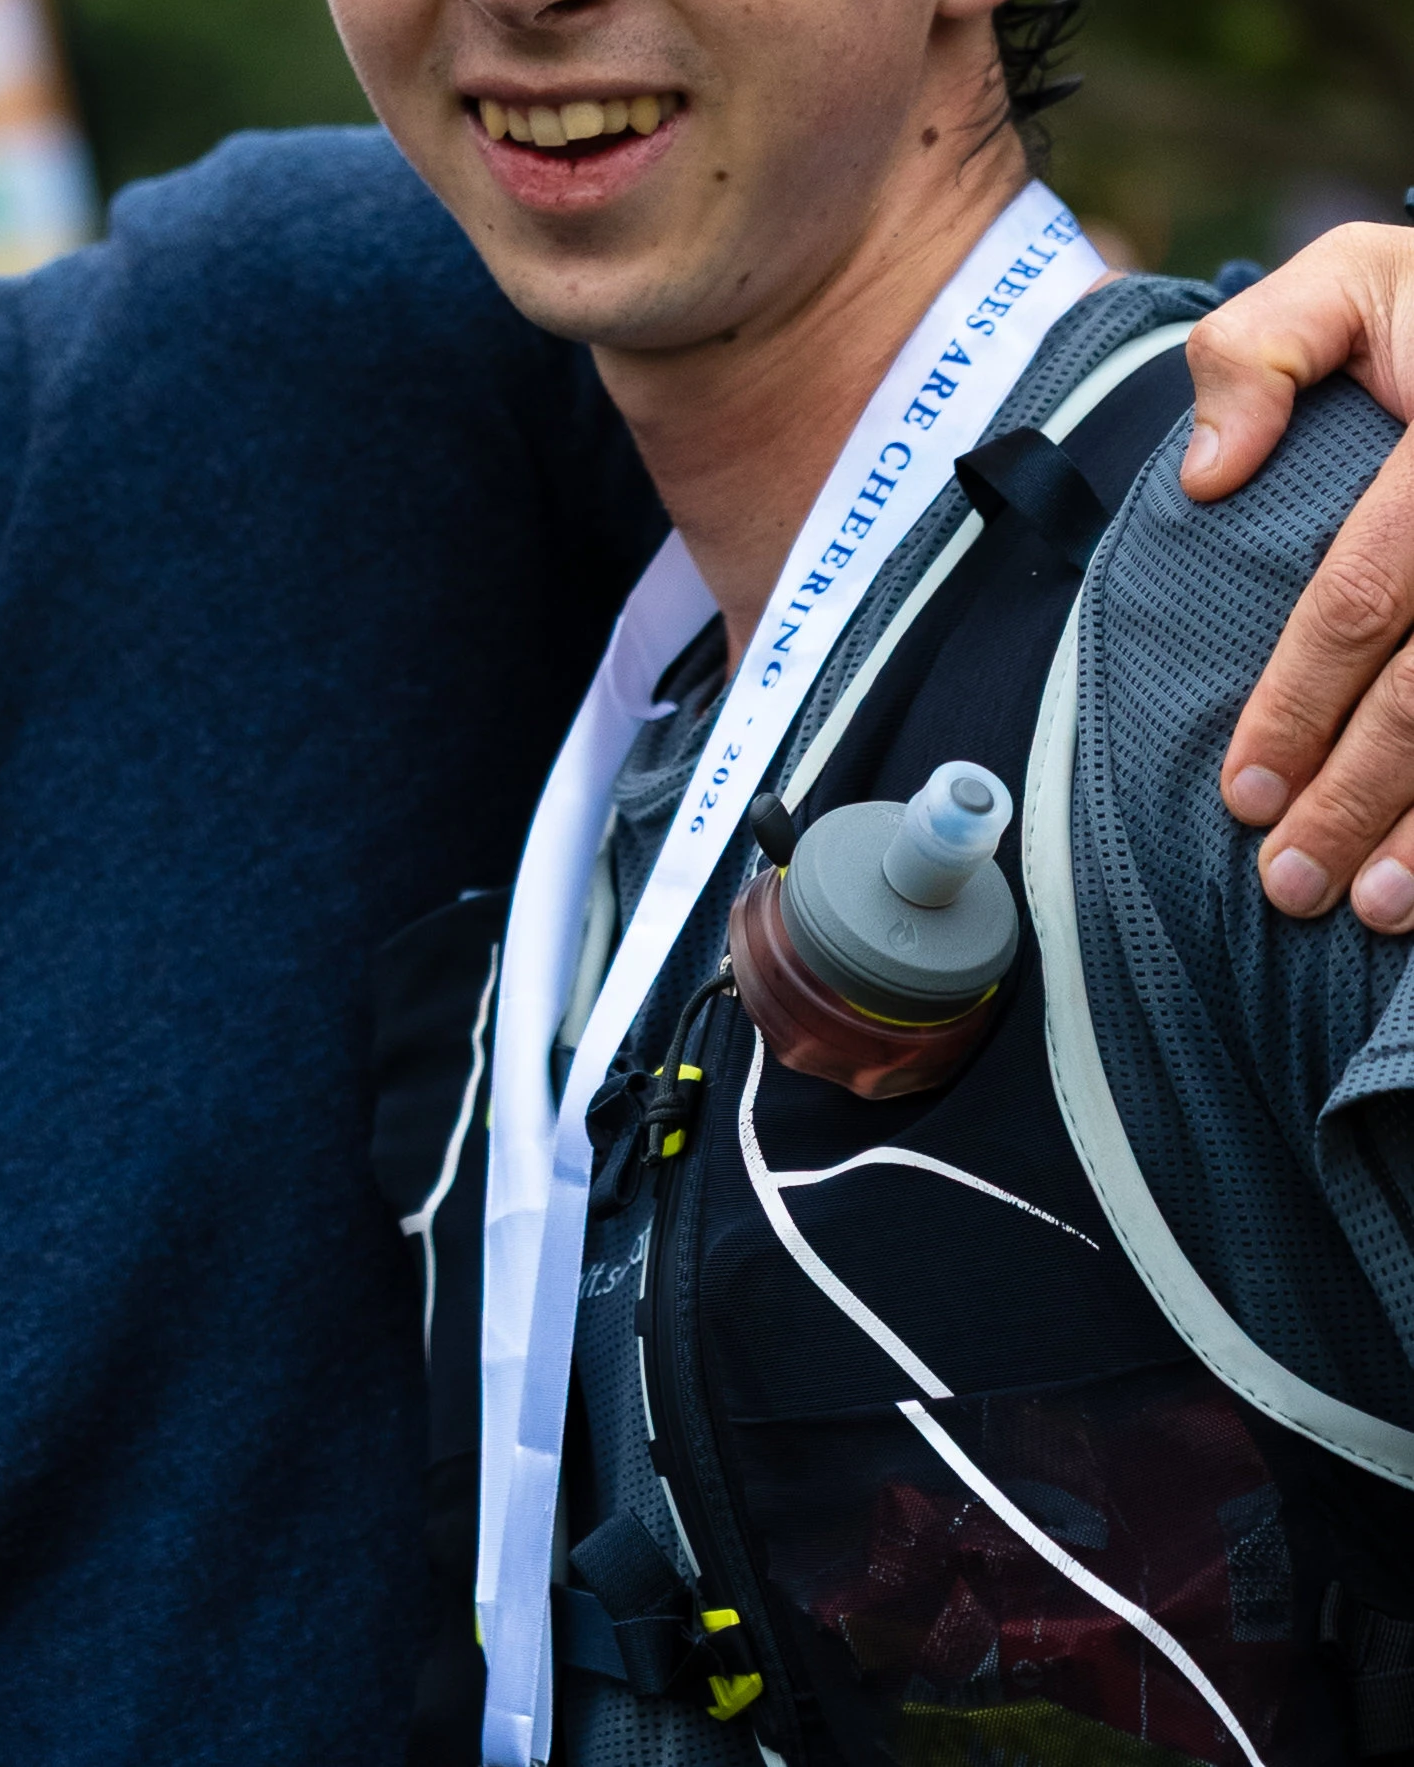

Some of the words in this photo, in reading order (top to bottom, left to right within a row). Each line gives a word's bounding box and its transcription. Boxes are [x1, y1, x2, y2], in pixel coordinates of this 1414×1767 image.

[1042, 207, 1083, 245] HE
[965, 243, 1059, 338] TREES
[902, 338, 973, 432] ARE
[761, 440, 912, 689] CHEERING
[690, 743, 742, 834] 2026
